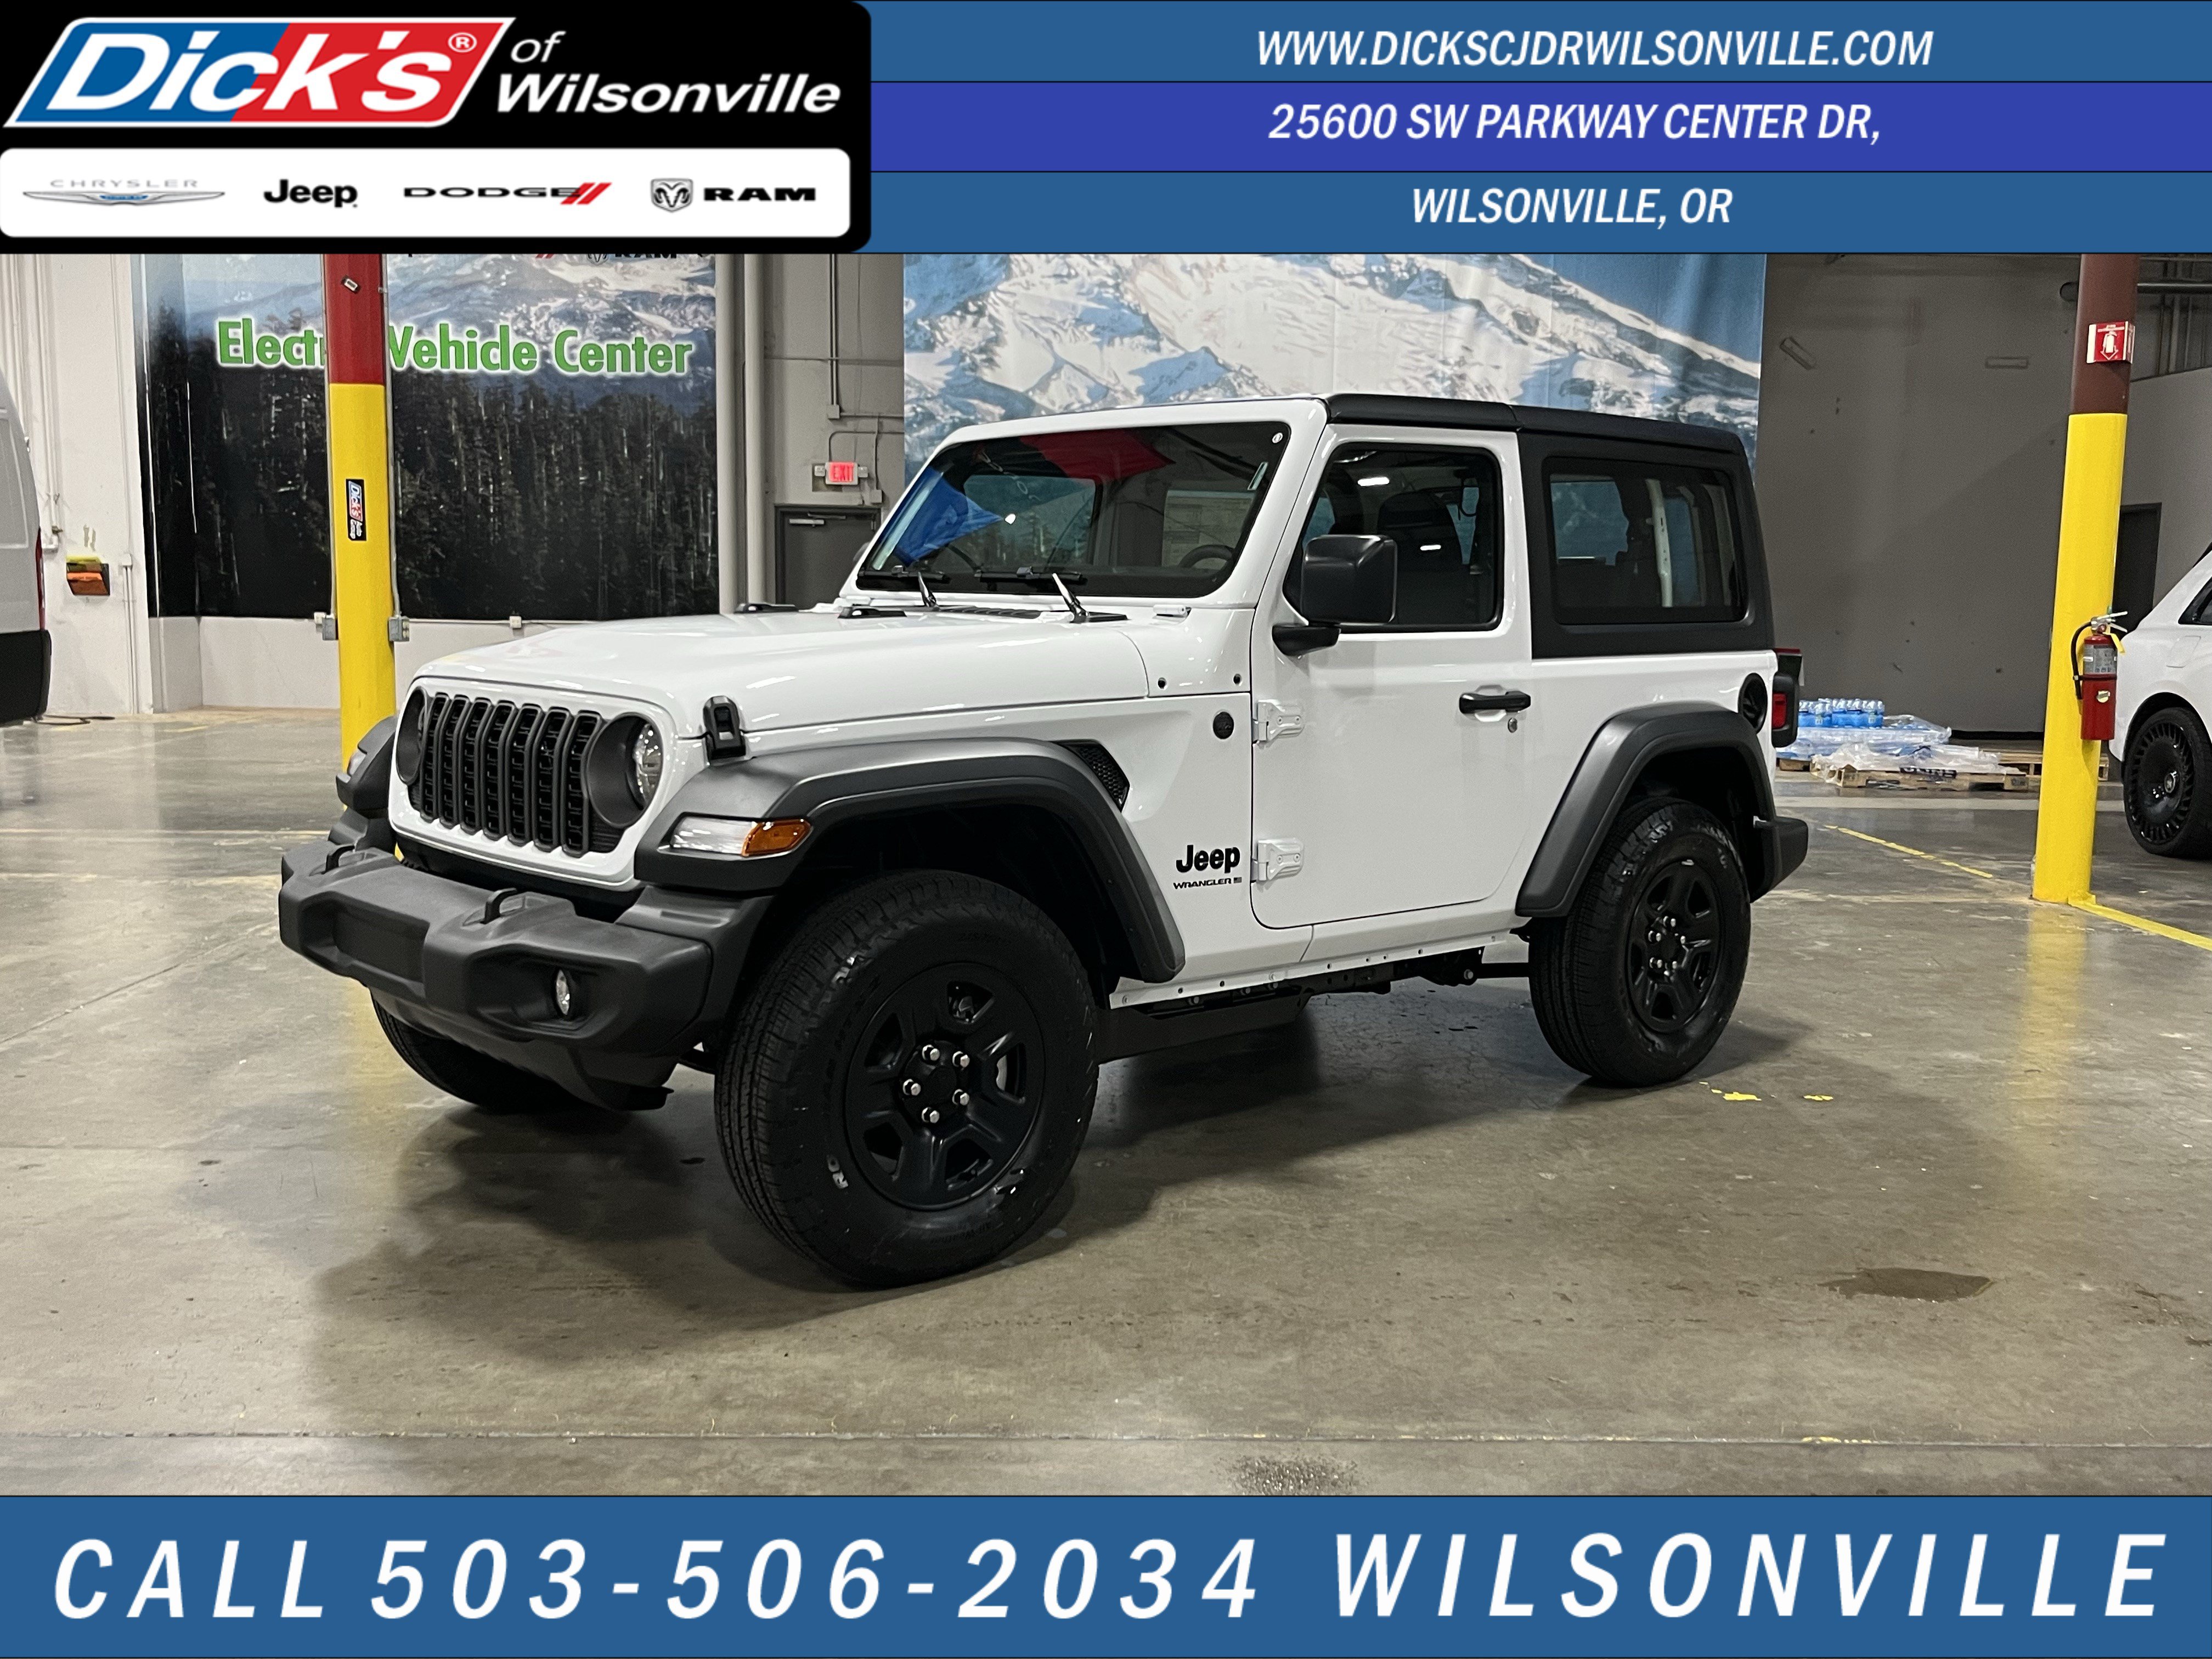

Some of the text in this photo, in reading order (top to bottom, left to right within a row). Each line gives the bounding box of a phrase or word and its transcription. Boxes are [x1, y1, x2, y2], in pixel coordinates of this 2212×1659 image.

[218, 318, 692, 373] Elect Vehicle Center
[831, 464, 854, 481] EXIT
[1176, 844, 1240, 874] Jeep
[1173, 878, 1232, 890] WRANGLER
